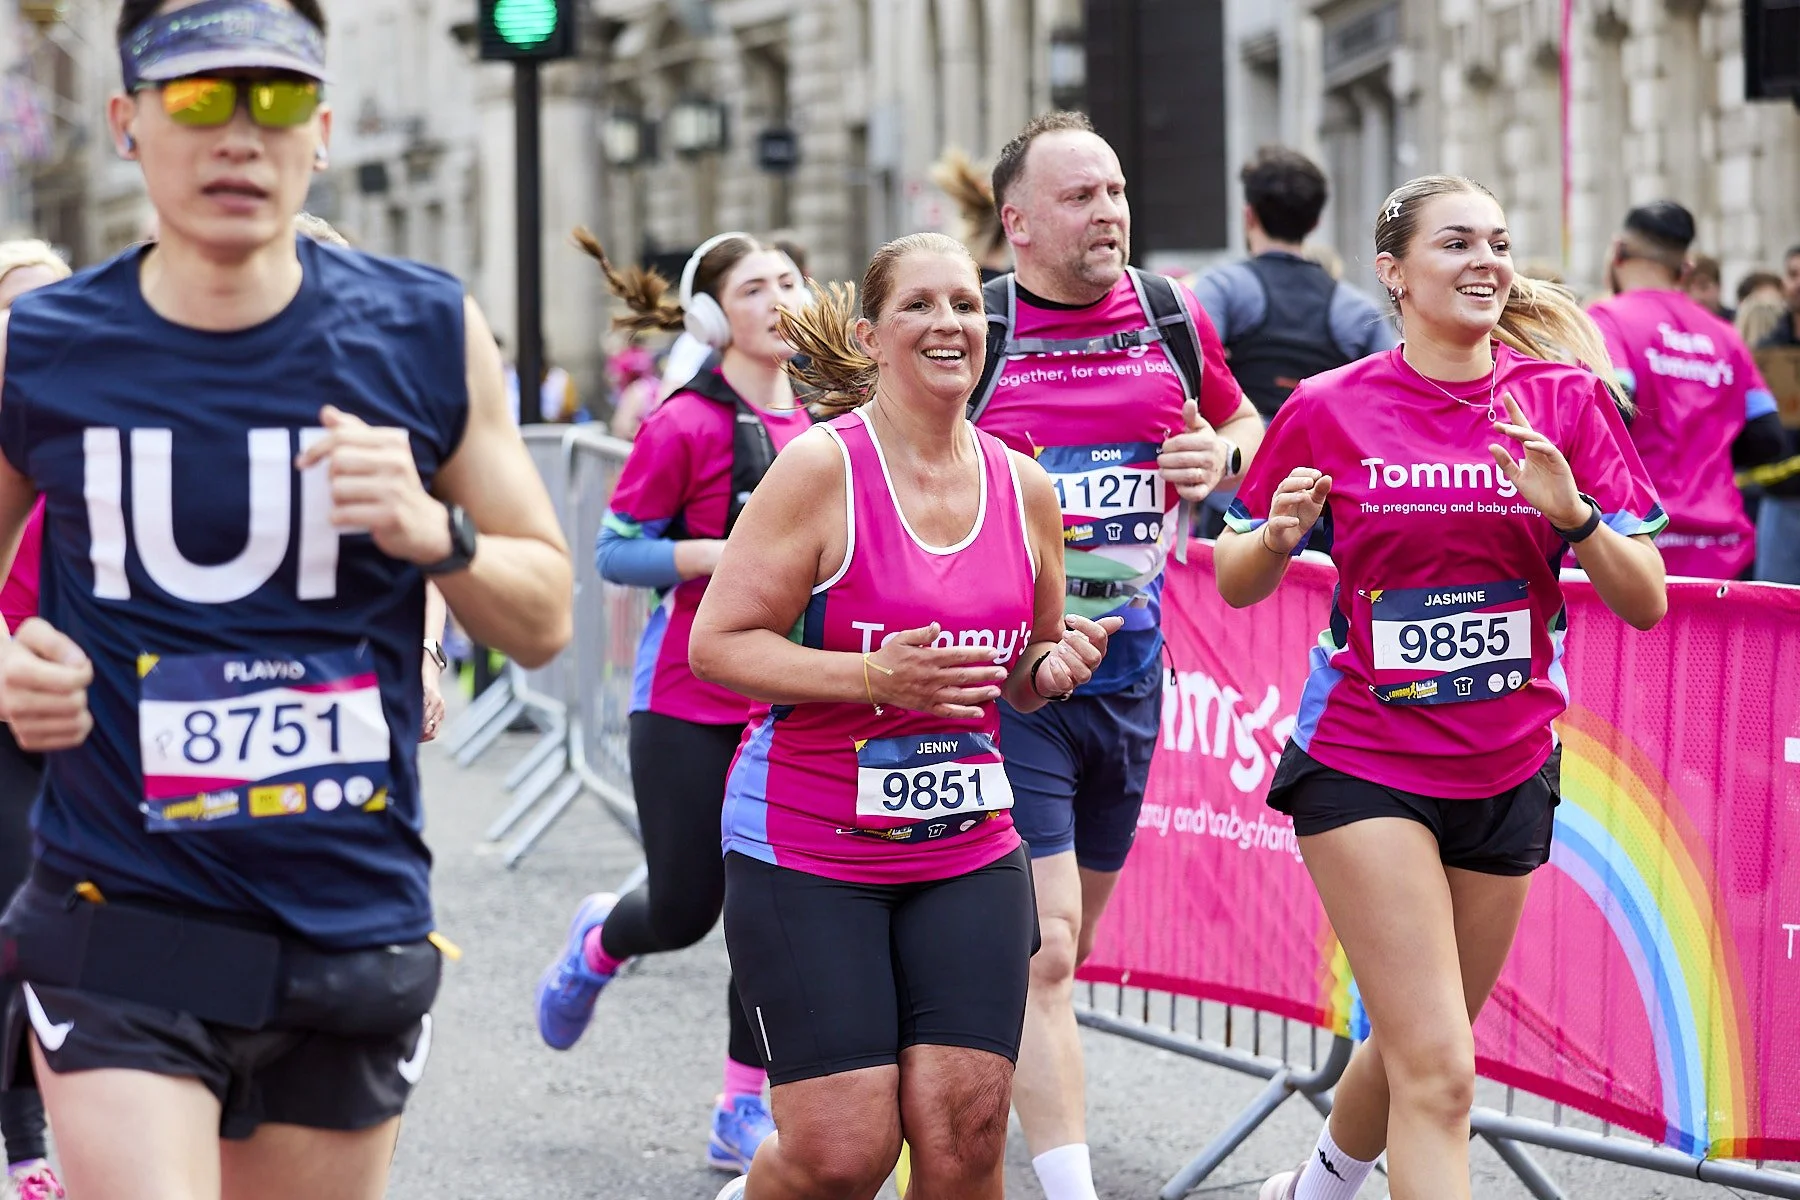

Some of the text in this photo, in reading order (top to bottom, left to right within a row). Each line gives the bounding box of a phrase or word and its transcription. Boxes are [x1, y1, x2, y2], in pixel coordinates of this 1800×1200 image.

[998, 360, 1177, 387] ogether, for every bab
[1091, 449, 1122, 462] DOM
[1054, 474, 1156, 509] 11271
[1360, 503, 1379, 513] The
[1383, 502, 1446, 515] pregnancy
[1450, 501, 1474, 513] and
[1478, 501, 1507, 516] baby
[1424, 590, 1486, 607] JASMINE
[1399, 616, 1510, 664] 9855
[223, 660, 306, 683] FLAVIO
[183, 702, 342, 764] 8751
[916, 740, 959, 755] JENNY
[882, 768, 985, 811] 9851
